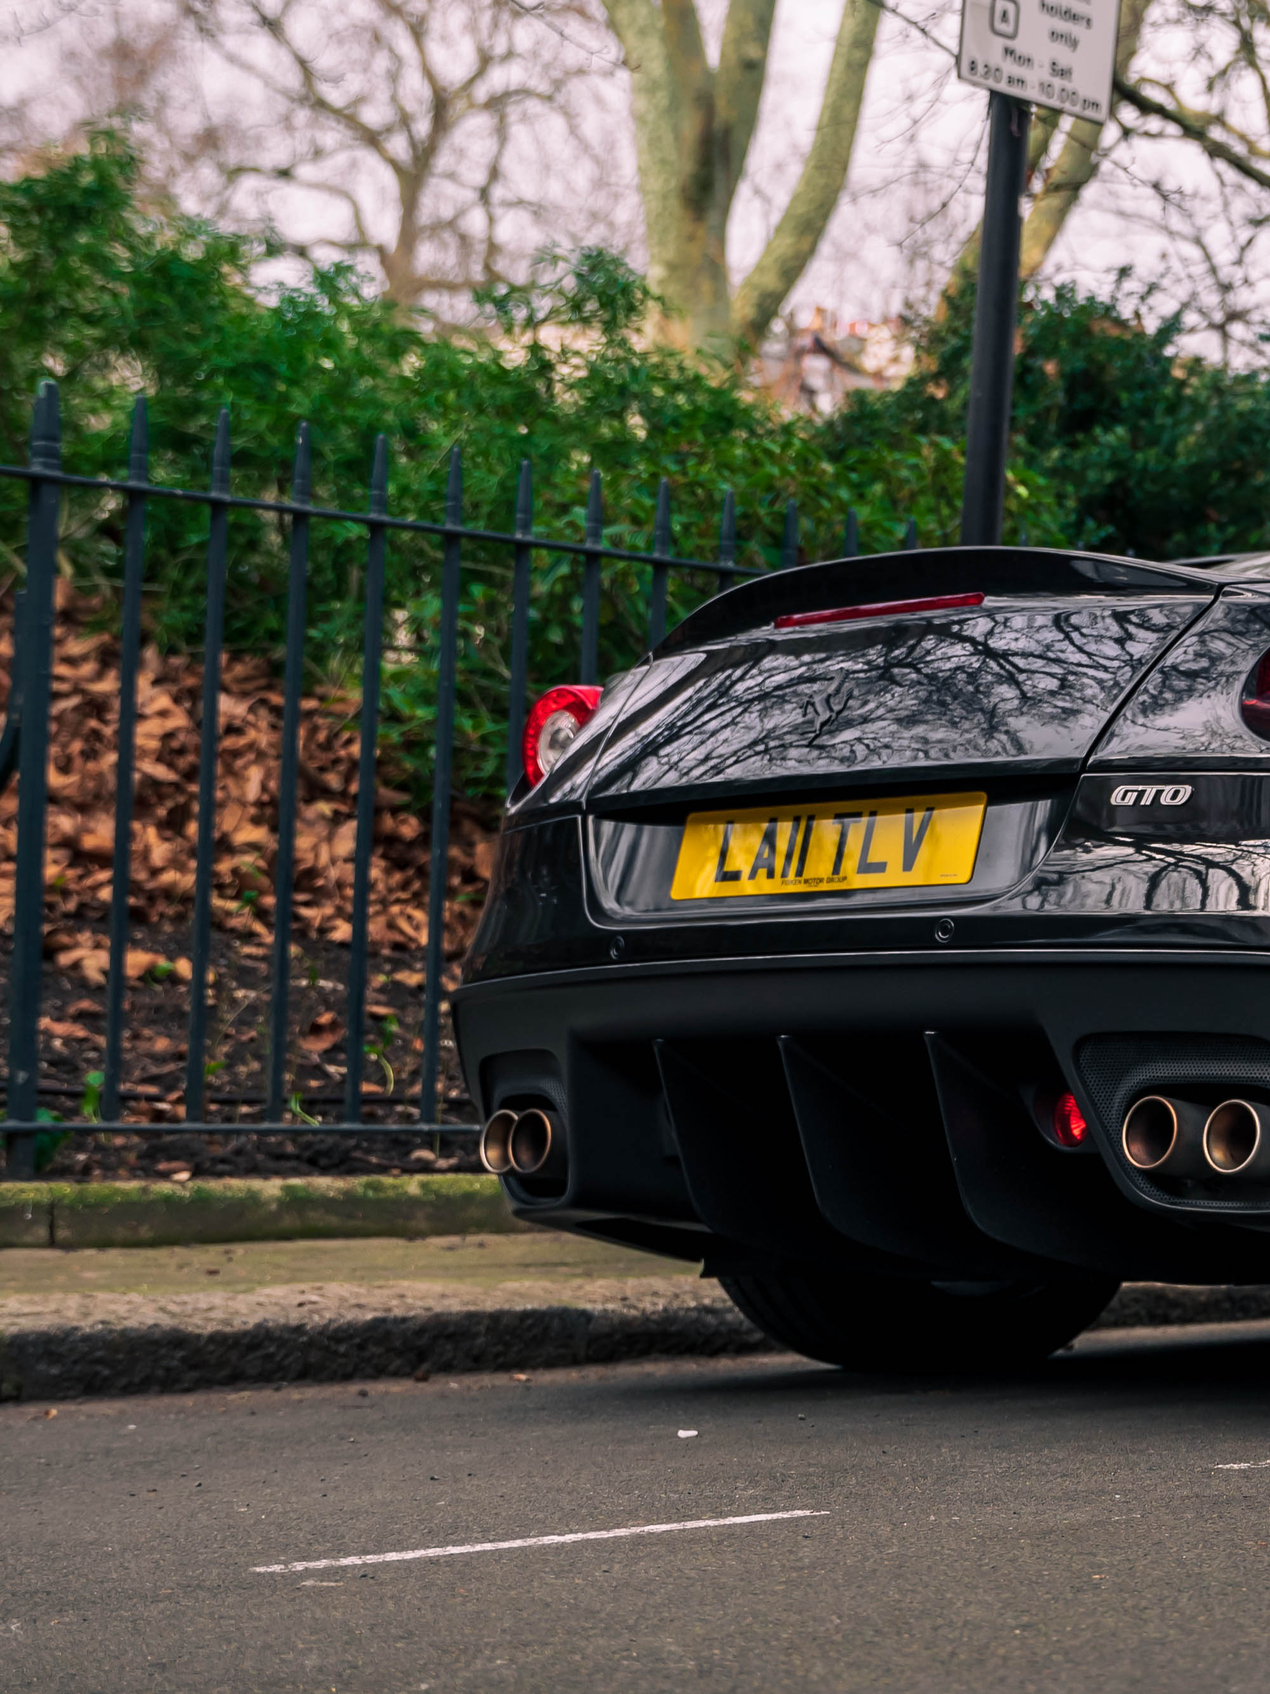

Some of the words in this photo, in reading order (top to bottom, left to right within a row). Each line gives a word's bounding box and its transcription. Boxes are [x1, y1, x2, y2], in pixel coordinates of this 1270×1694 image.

[1039, 1, 1093, 29] holders
[1050, 30, 1080, 52] only
[1003, 47, 1034, 69] Mon
[1049, 60, 1073, 82] Sat
[1110, 785, 1192, 805] GTO
[831, 807, 935, 876] TLV
[803, 877, 825, 885] MOTOR
[826, 876, 848, 884] GROUP
